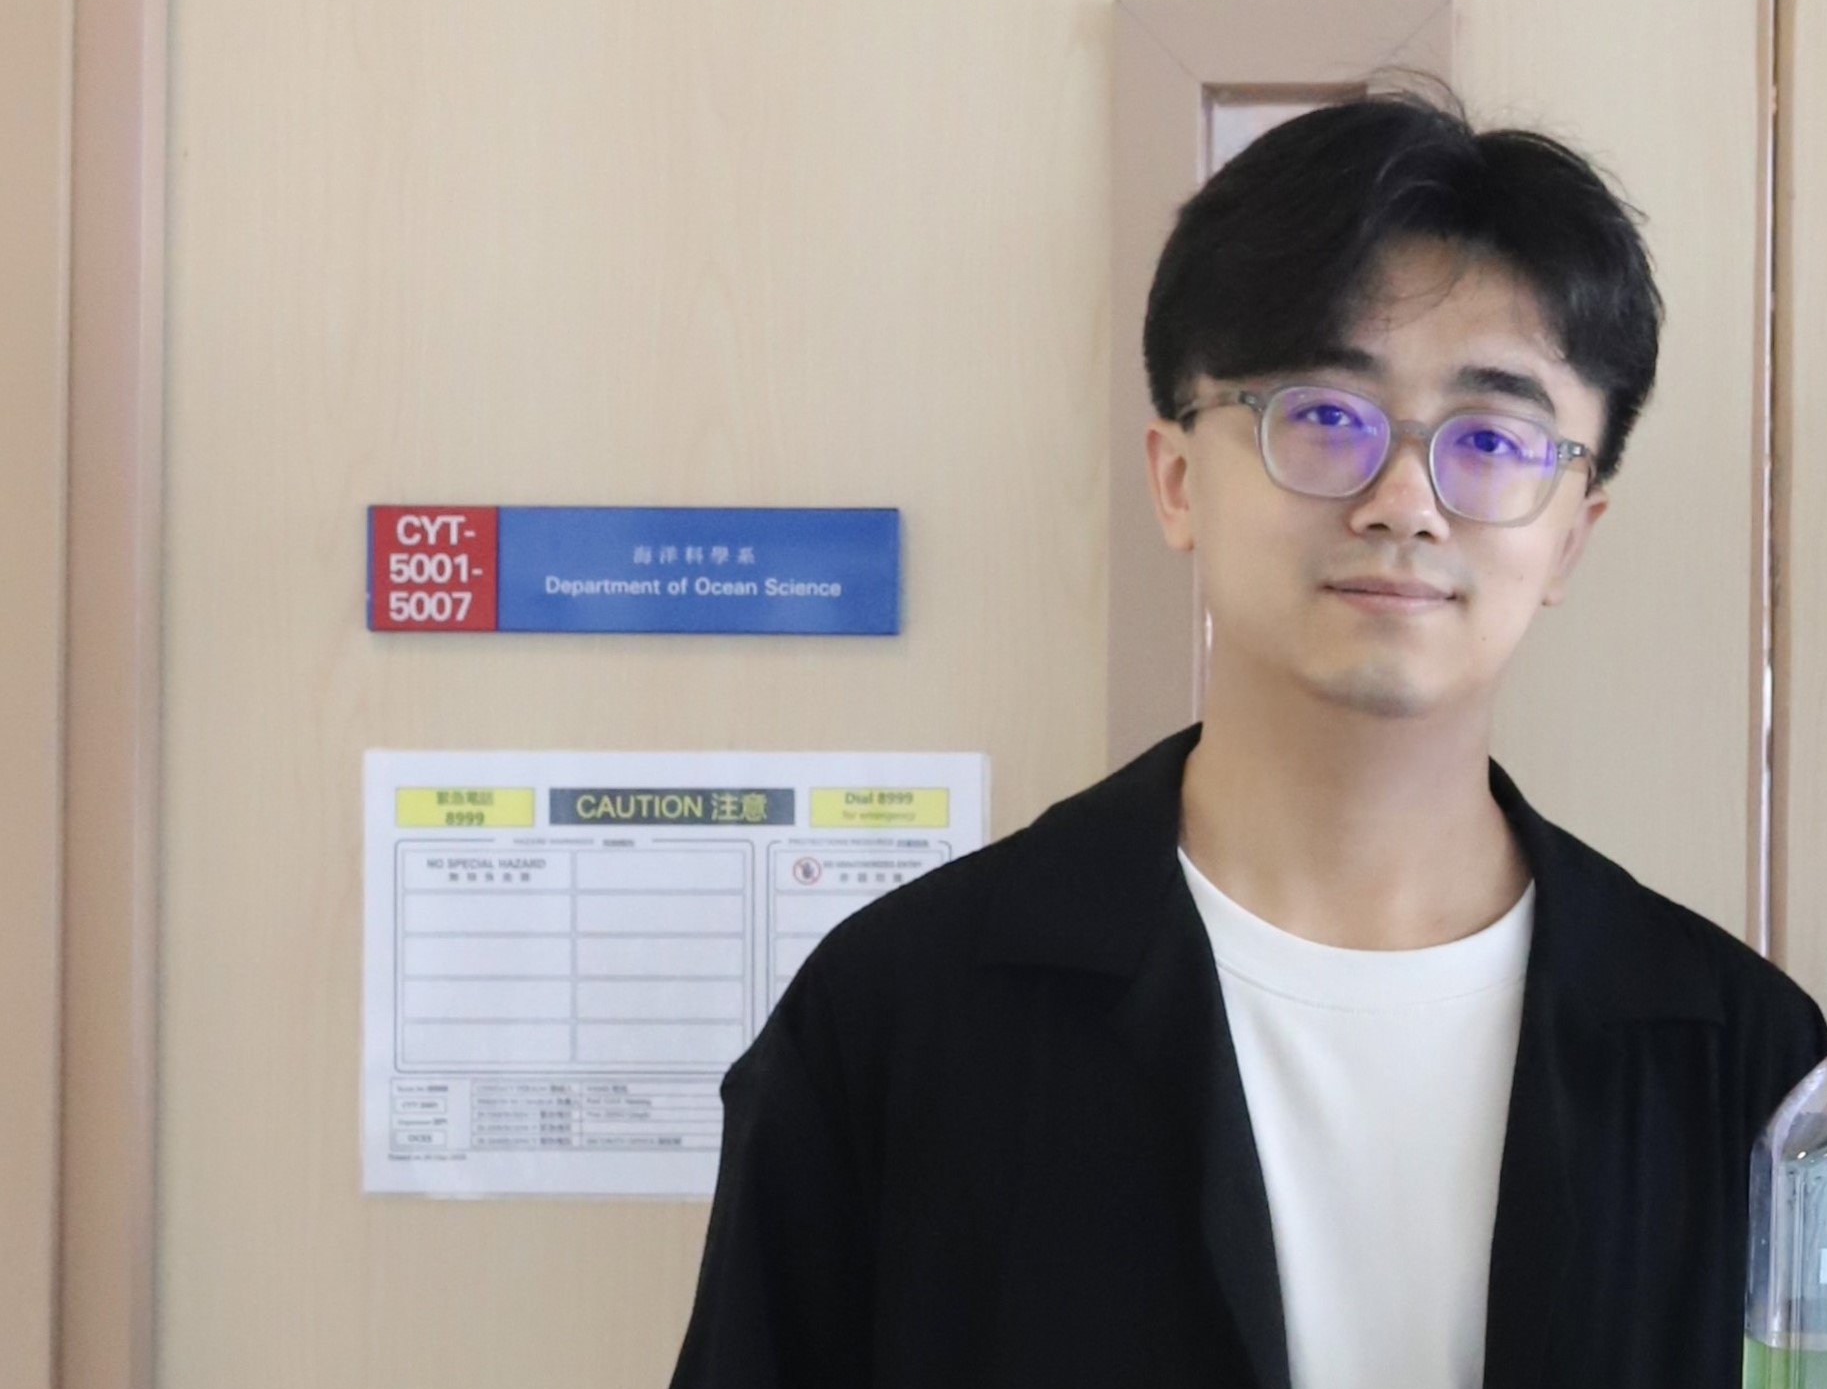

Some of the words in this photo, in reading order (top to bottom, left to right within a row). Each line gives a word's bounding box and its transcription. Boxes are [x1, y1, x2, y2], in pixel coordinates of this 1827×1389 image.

[396, 515, 476, 546] CYT-
[633, 546, 756, 565] 海洋科學系
[389, 553, 483, 584] 5001-
[545, 576, 661, 597] Department
[667, 577, 687, 595] of
[694, 577, 758, 596] Ocean
[765, 578, 842, 597] Science
[389, 591, 473, 622] 5007
[576, 794, 703, 820] CAUTION
[711, 792, 768, 823] 注意
[844, 791, 873, 805] Dial
[877, 791, 914, 805] 8999
[445, 811, 485, 827] 8999
[447, 858, 494, 869] SPECIAL
[498, 859, 547, 869] HAZARD
